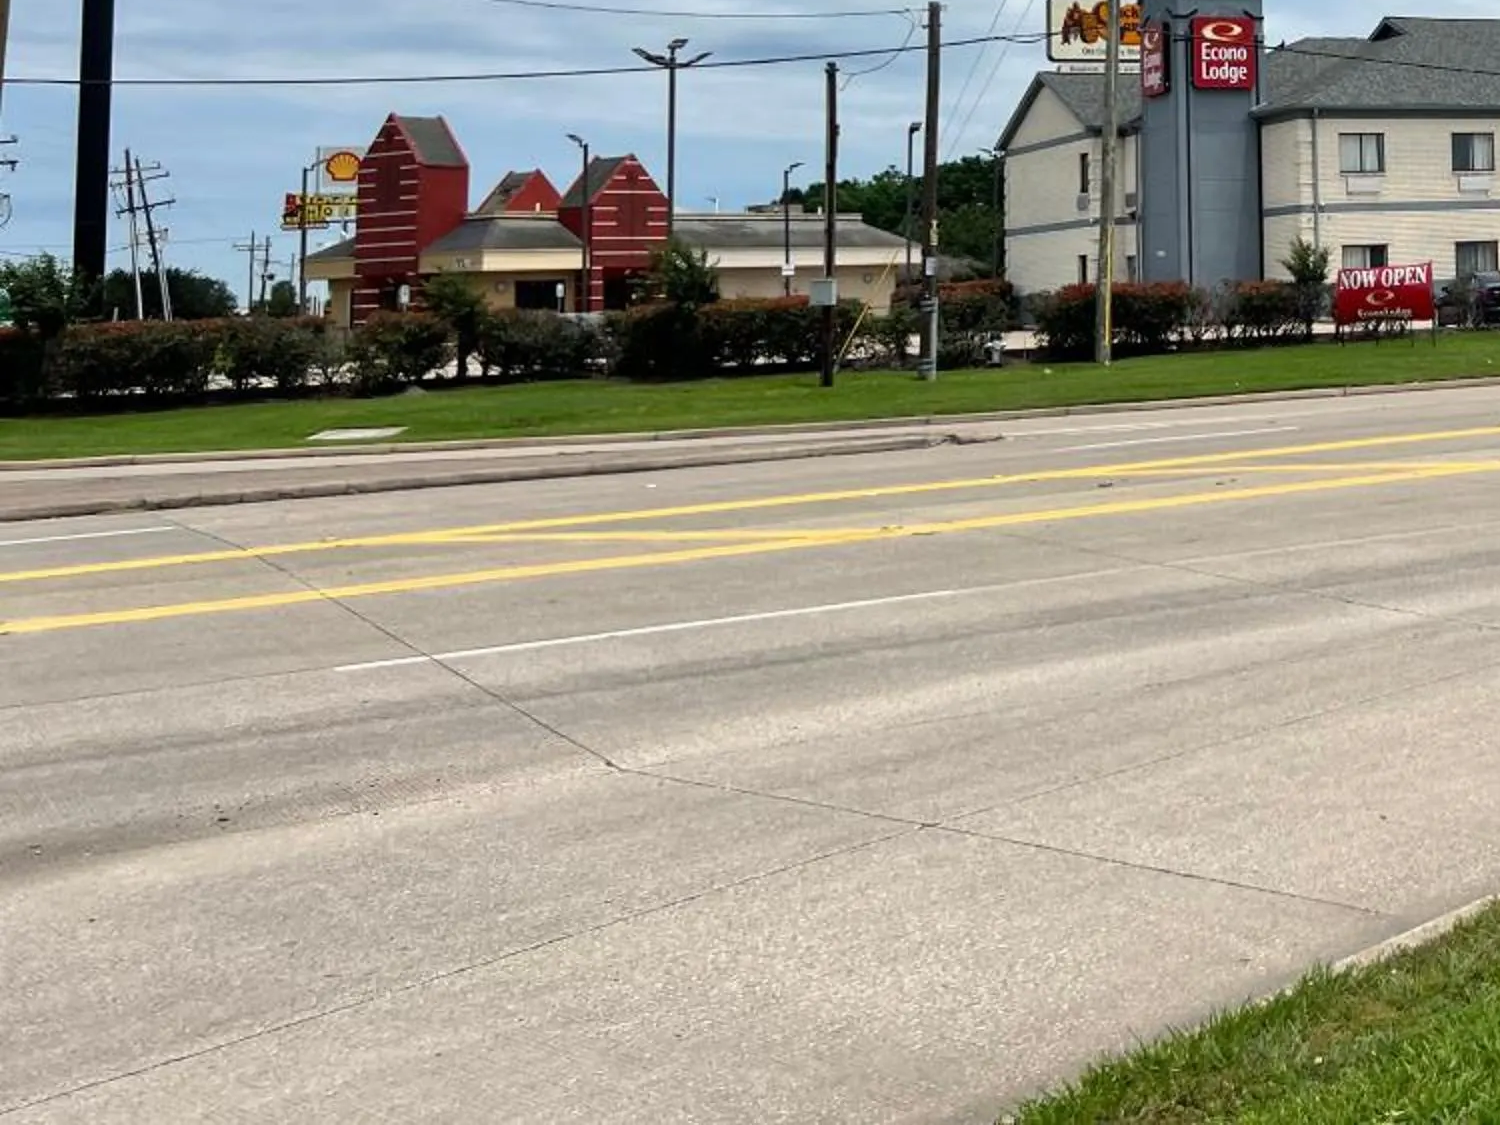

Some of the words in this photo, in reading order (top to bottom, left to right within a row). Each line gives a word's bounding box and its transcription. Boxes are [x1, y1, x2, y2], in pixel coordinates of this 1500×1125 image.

[1201, 42, 1248, 61] Econo
[1202, 61, 1248, 85] Lodge
[1340, 270, 1378, 290] NOW
[1381, 265, 1428, 287] OPEN
